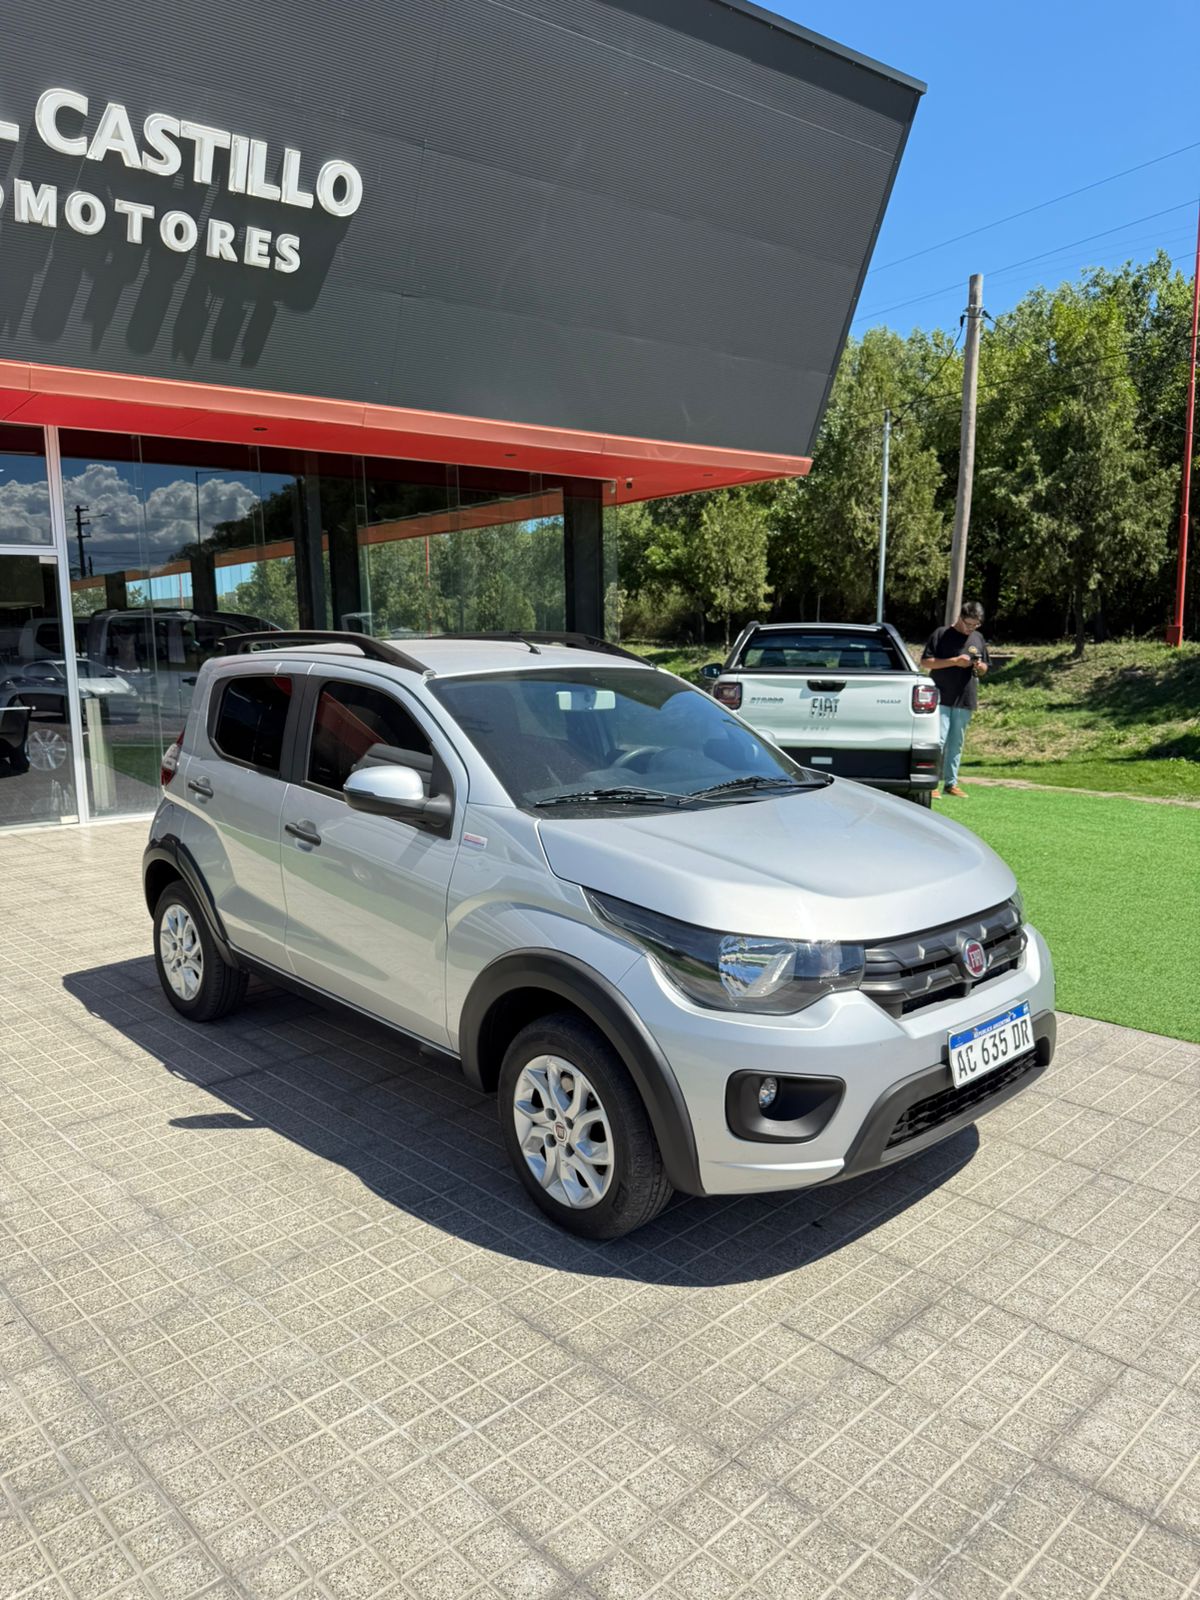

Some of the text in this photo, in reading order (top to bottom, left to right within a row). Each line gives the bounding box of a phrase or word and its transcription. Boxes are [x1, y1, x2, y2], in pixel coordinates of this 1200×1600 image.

[35, 88, 363, 217] CASTILLO
[0, 178, 301, 274] MOTORES
[811, 697, 840, 714] FIAT
[957, 1045, 977, 1078] AC
[981, 1029, 1008, 1065] 635
[1011, 1019, 1030, 1050] DR
